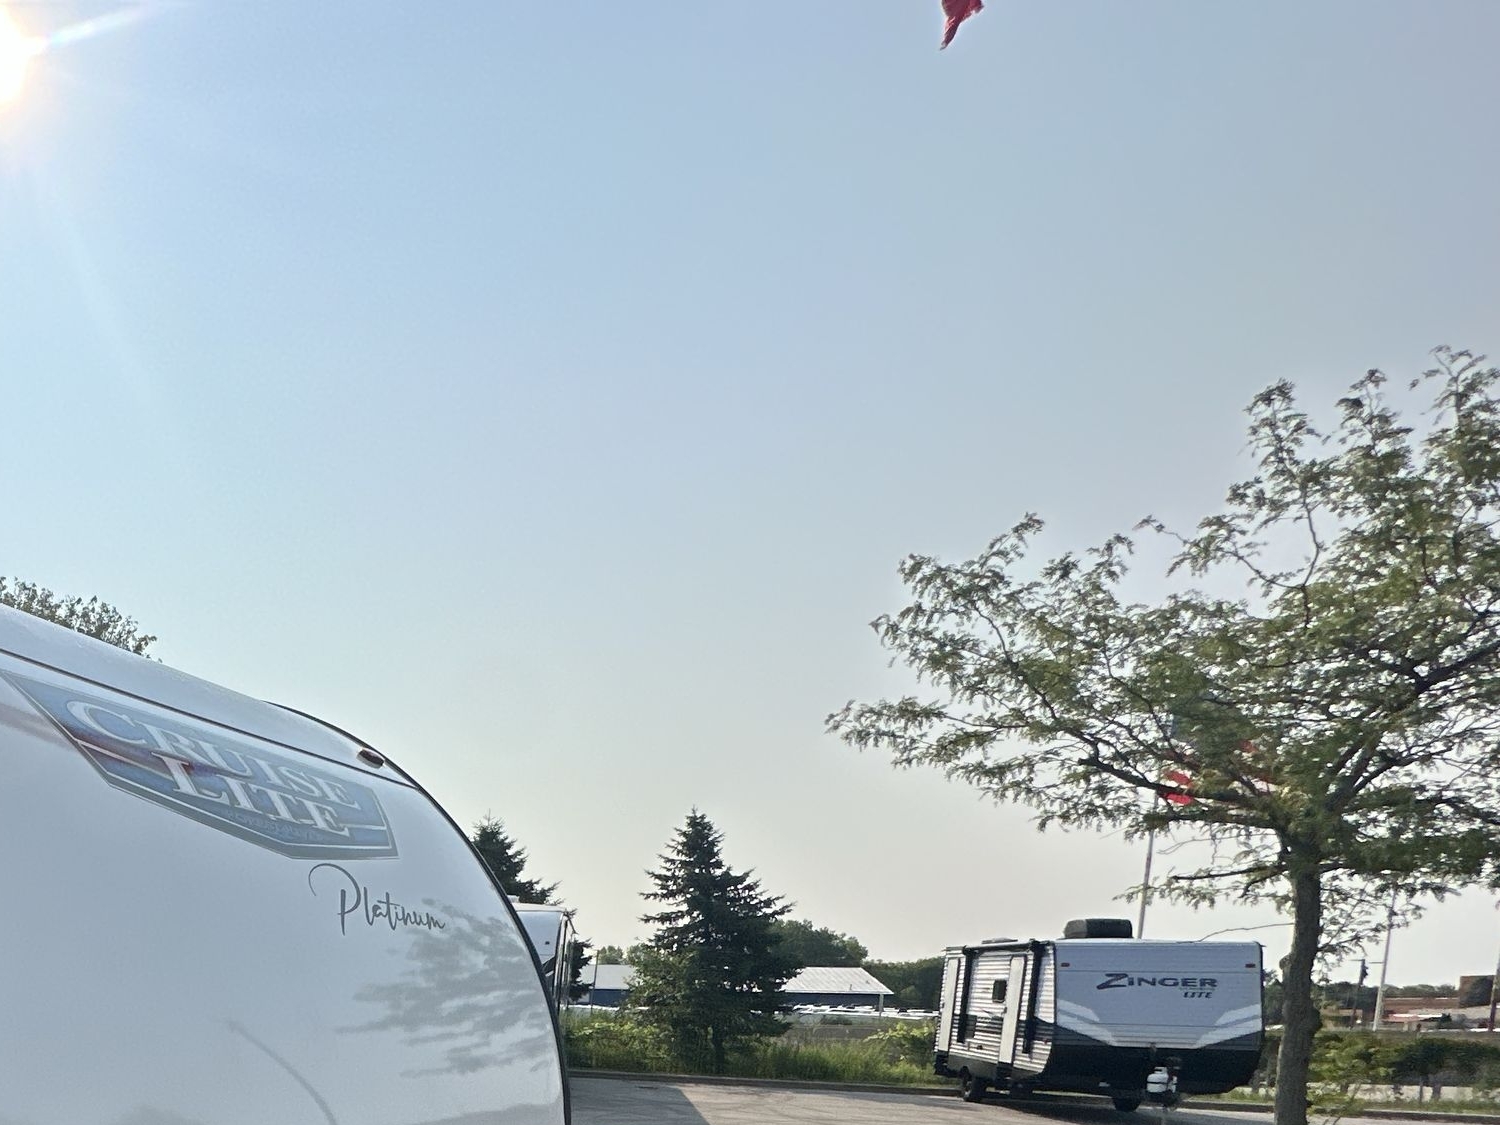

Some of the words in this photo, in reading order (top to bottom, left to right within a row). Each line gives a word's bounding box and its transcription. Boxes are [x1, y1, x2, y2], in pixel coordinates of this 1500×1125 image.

[66, 700, 361, 810] CRUISE
[151, 751, 351, 837] LITE
[308, 862, 446, 936] Platinum
[1096, 972, 1218, 990] ZINGER
